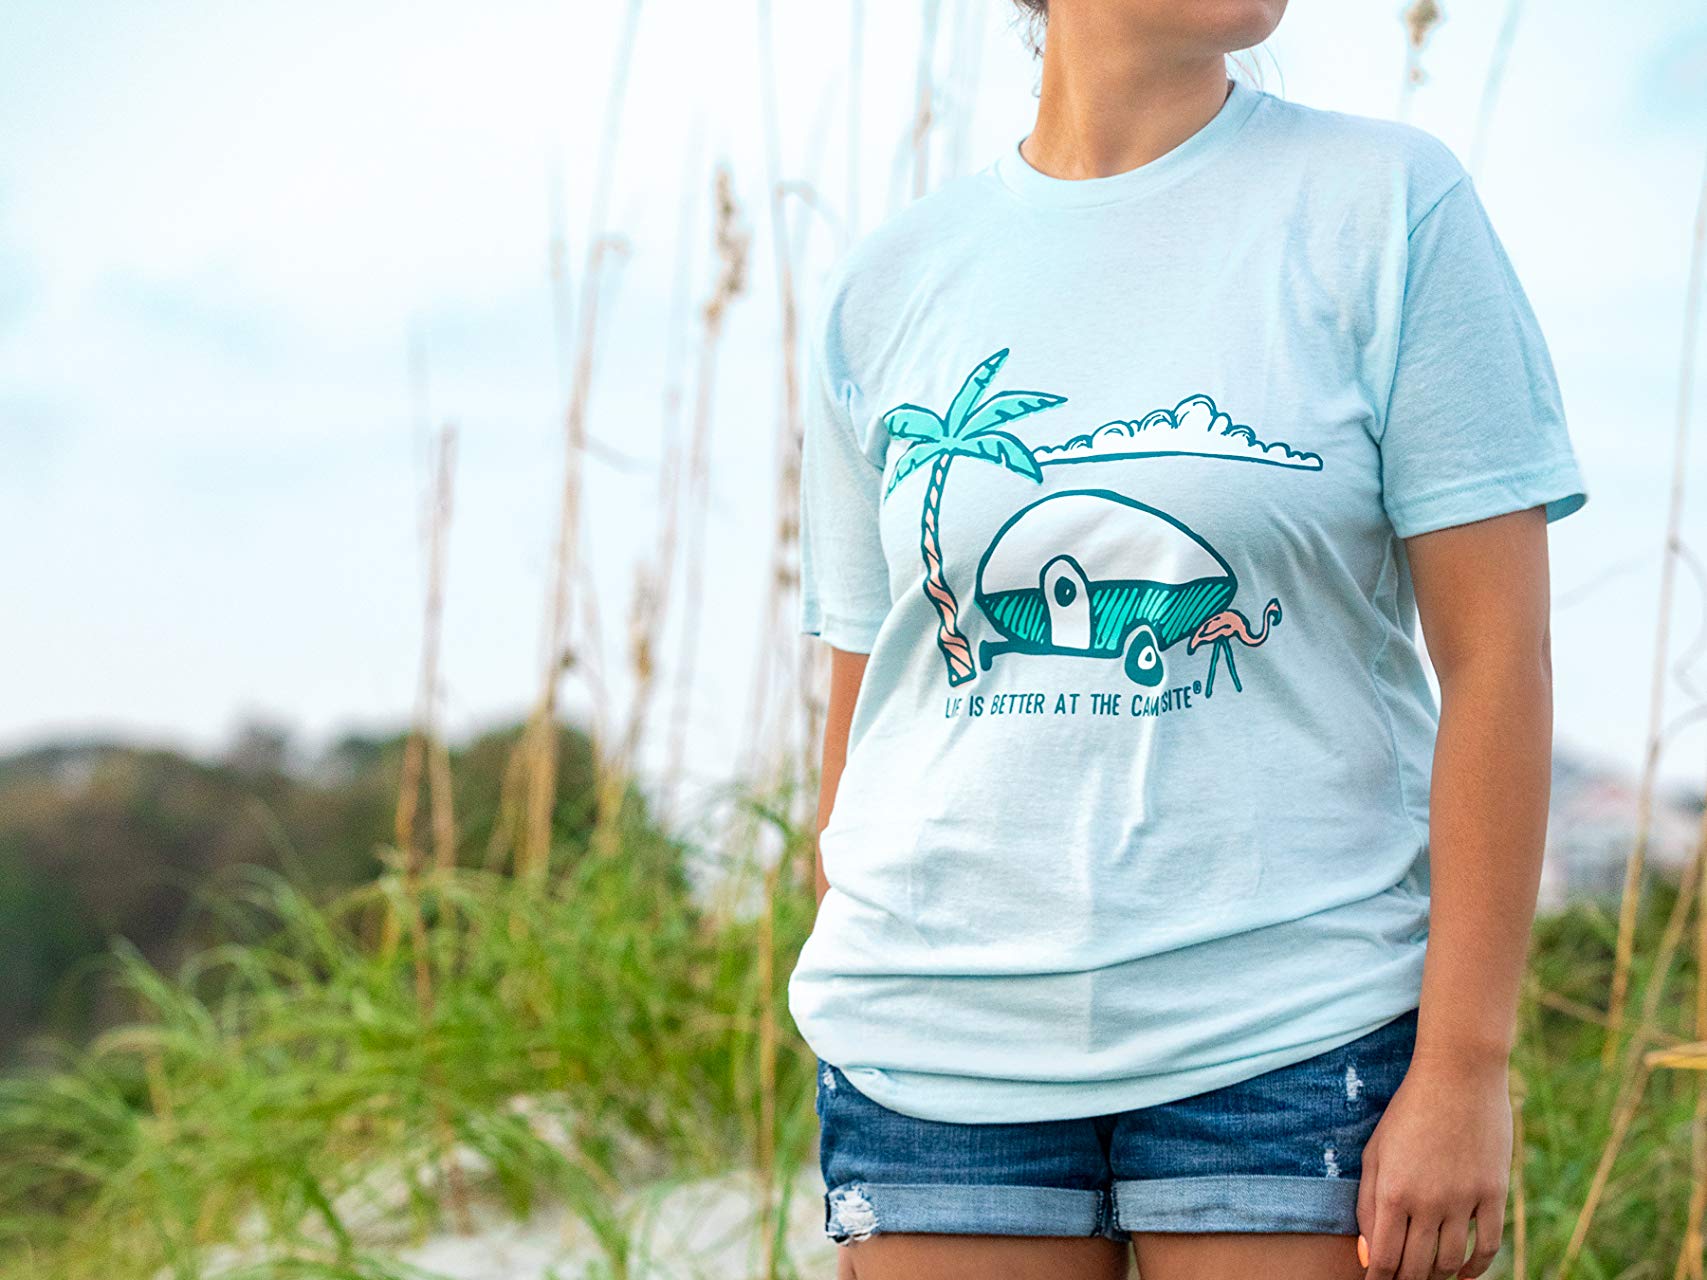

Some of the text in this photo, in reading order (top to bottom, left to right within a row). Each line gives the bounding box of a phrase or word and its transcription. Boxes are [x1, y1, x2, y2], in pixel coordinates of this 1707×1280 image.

[968, 695, 984, 717] IS
[990, 693, 1046, 715] BETTER
[1053, 693, 1081, 715] AT
[1090, 693, 1120, 716] THE
